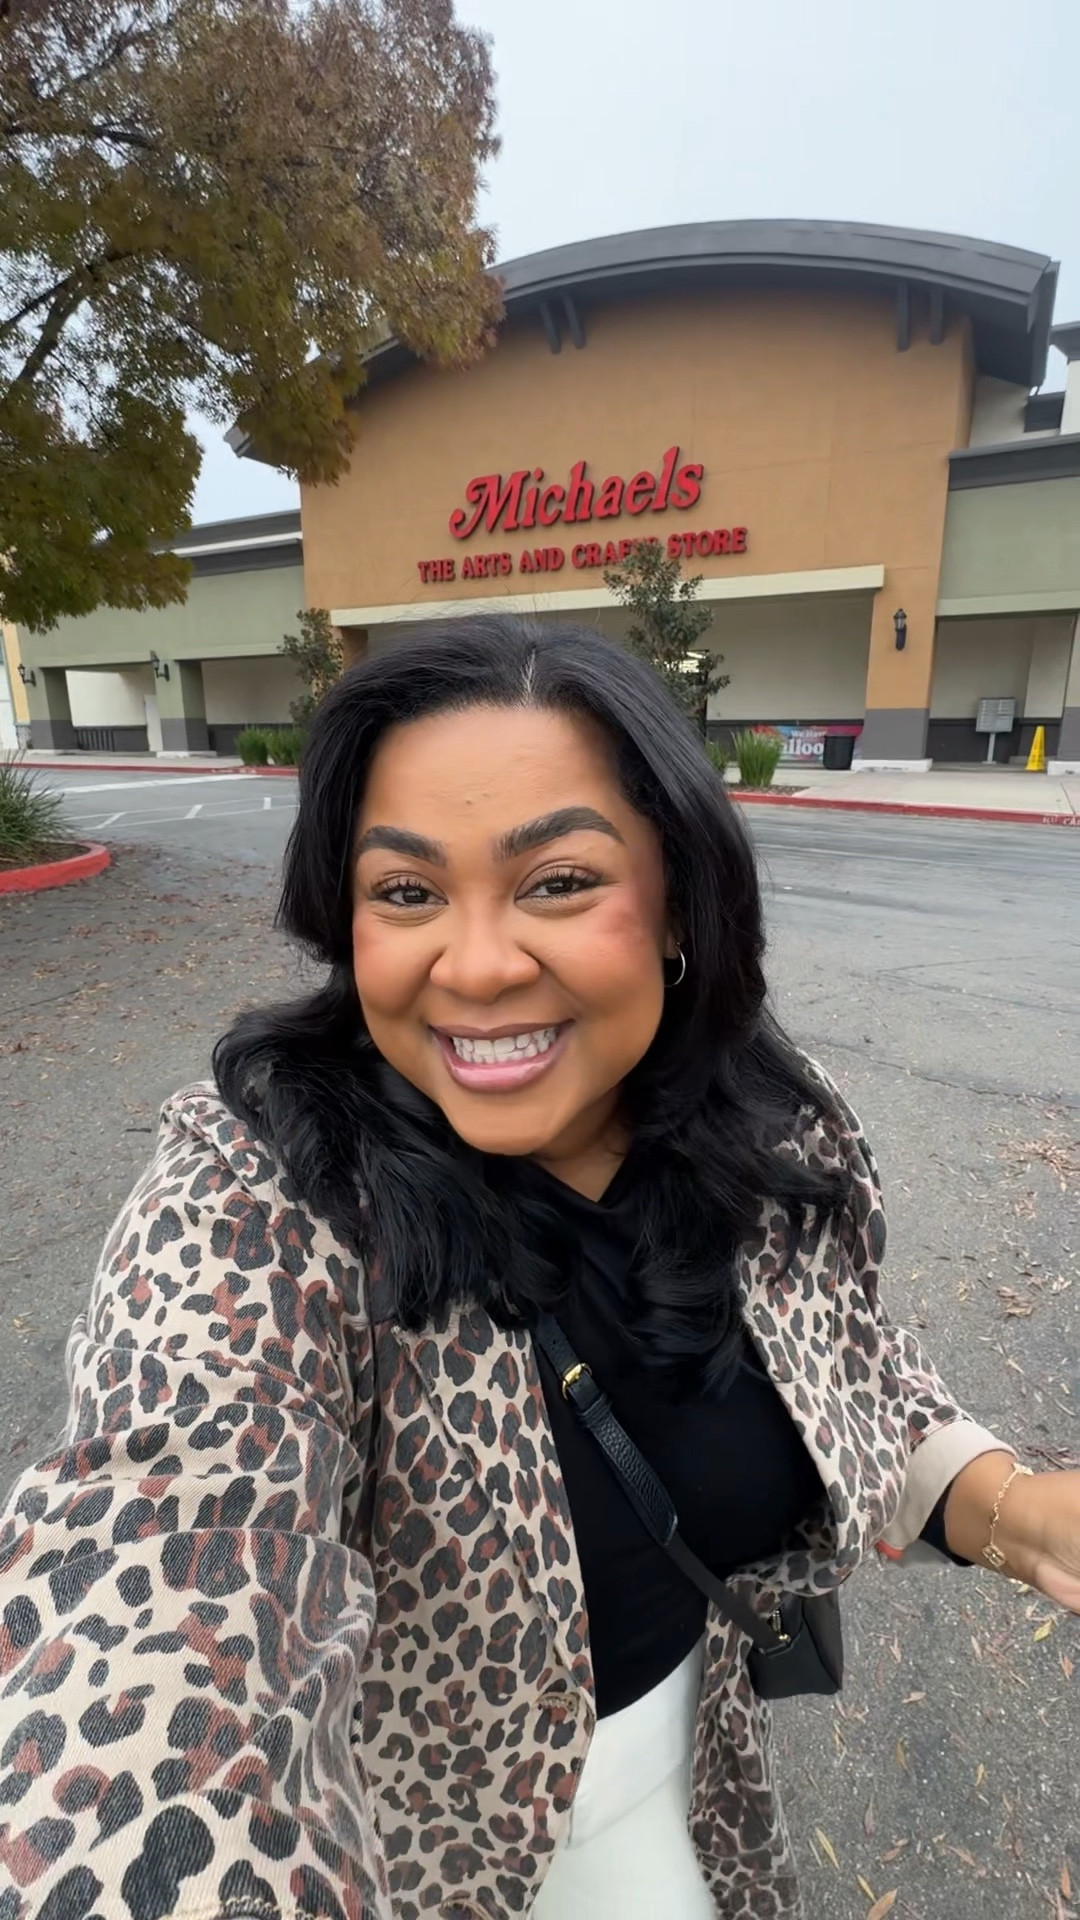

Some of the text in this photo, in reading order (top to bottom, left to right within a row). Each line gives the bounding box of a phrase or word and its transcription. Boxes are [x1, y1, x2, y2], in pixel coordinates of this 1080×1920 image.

[449, 445, 704, 540] Michaels
[417, 527, 748, 583] THE ARTS AND CRAF STORE
